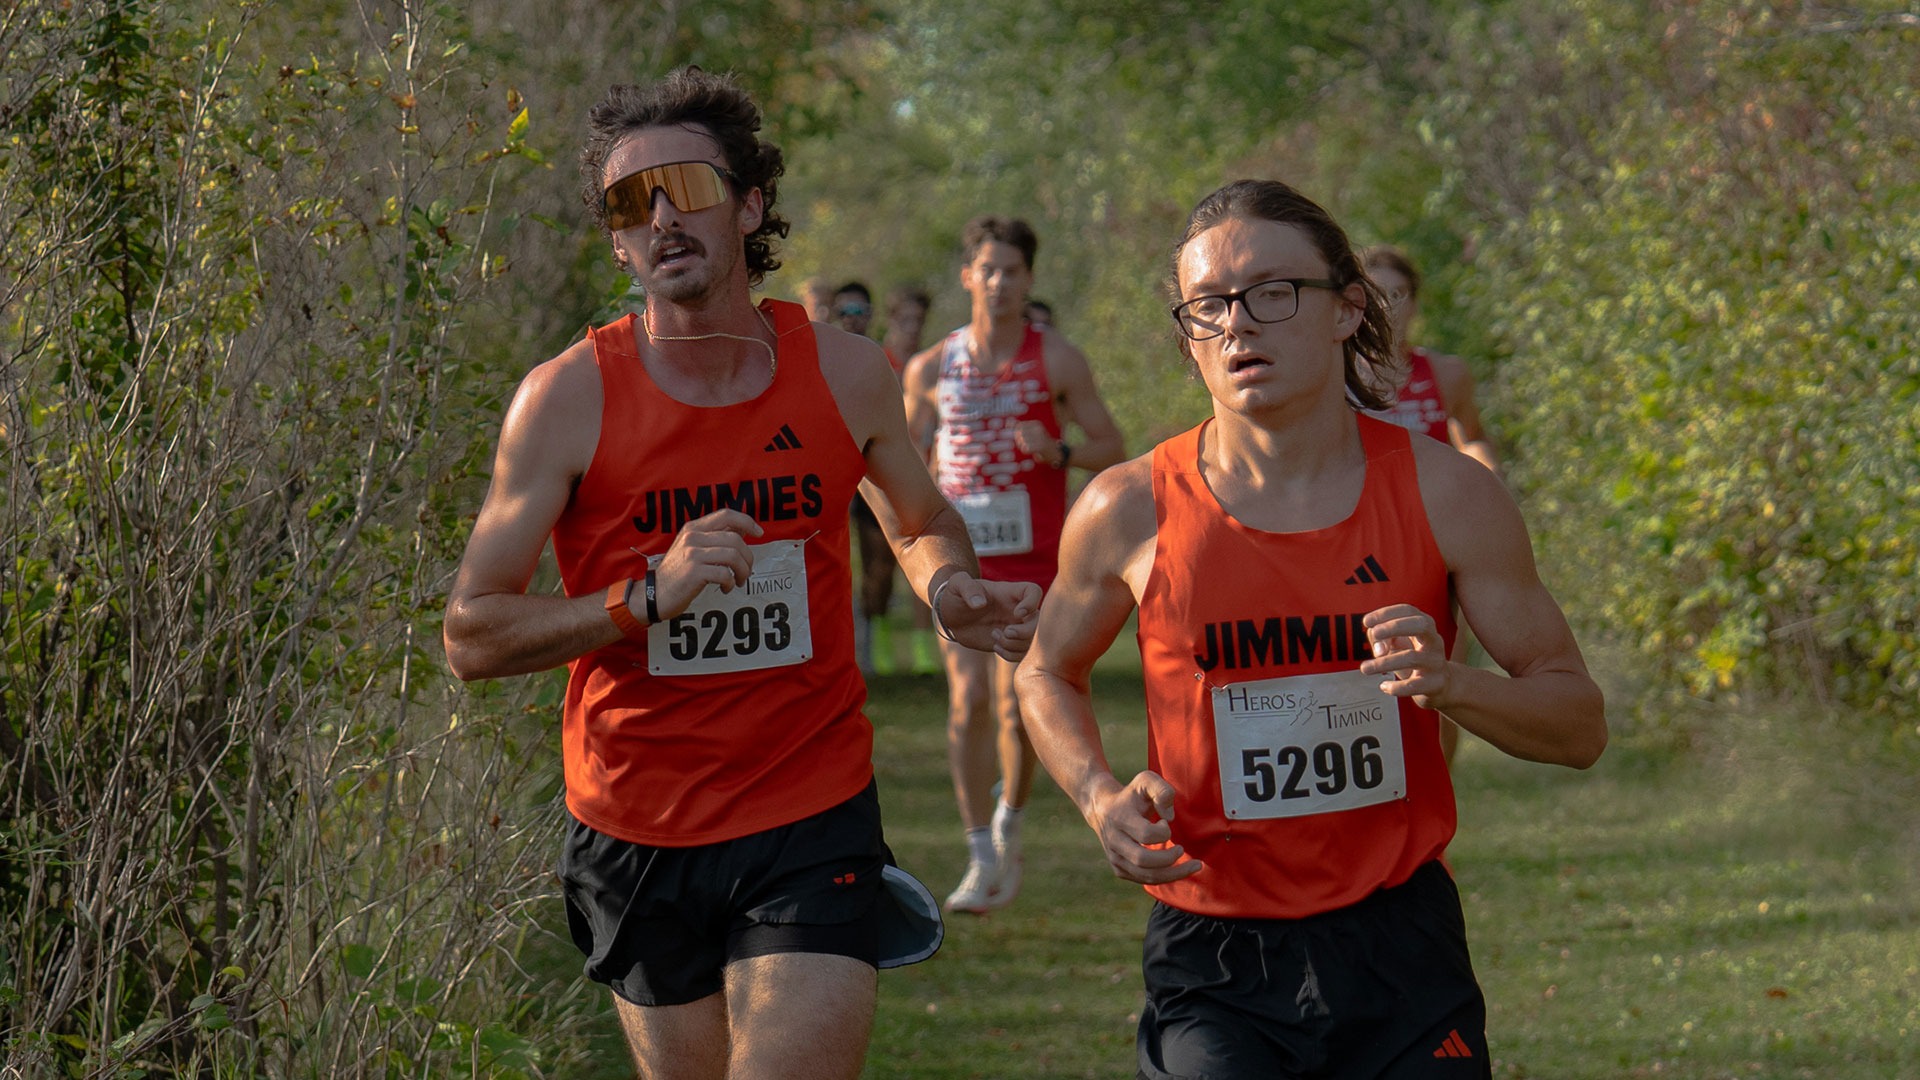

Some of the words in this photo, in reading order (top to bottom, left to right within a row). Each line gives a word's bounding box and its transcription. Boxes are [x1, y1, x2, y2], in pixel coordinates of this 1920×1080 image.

[632, 473, 823, 534] JIMMIES
[669, 600, 791, 662] 5293
[1194, 613, 1374, 672] JIMMIE
[1227, 687, 1296, 713] HERO'S
[1318, 703, 1383, 730] TIMING
[1241, 735, 1384, 803] 5296
